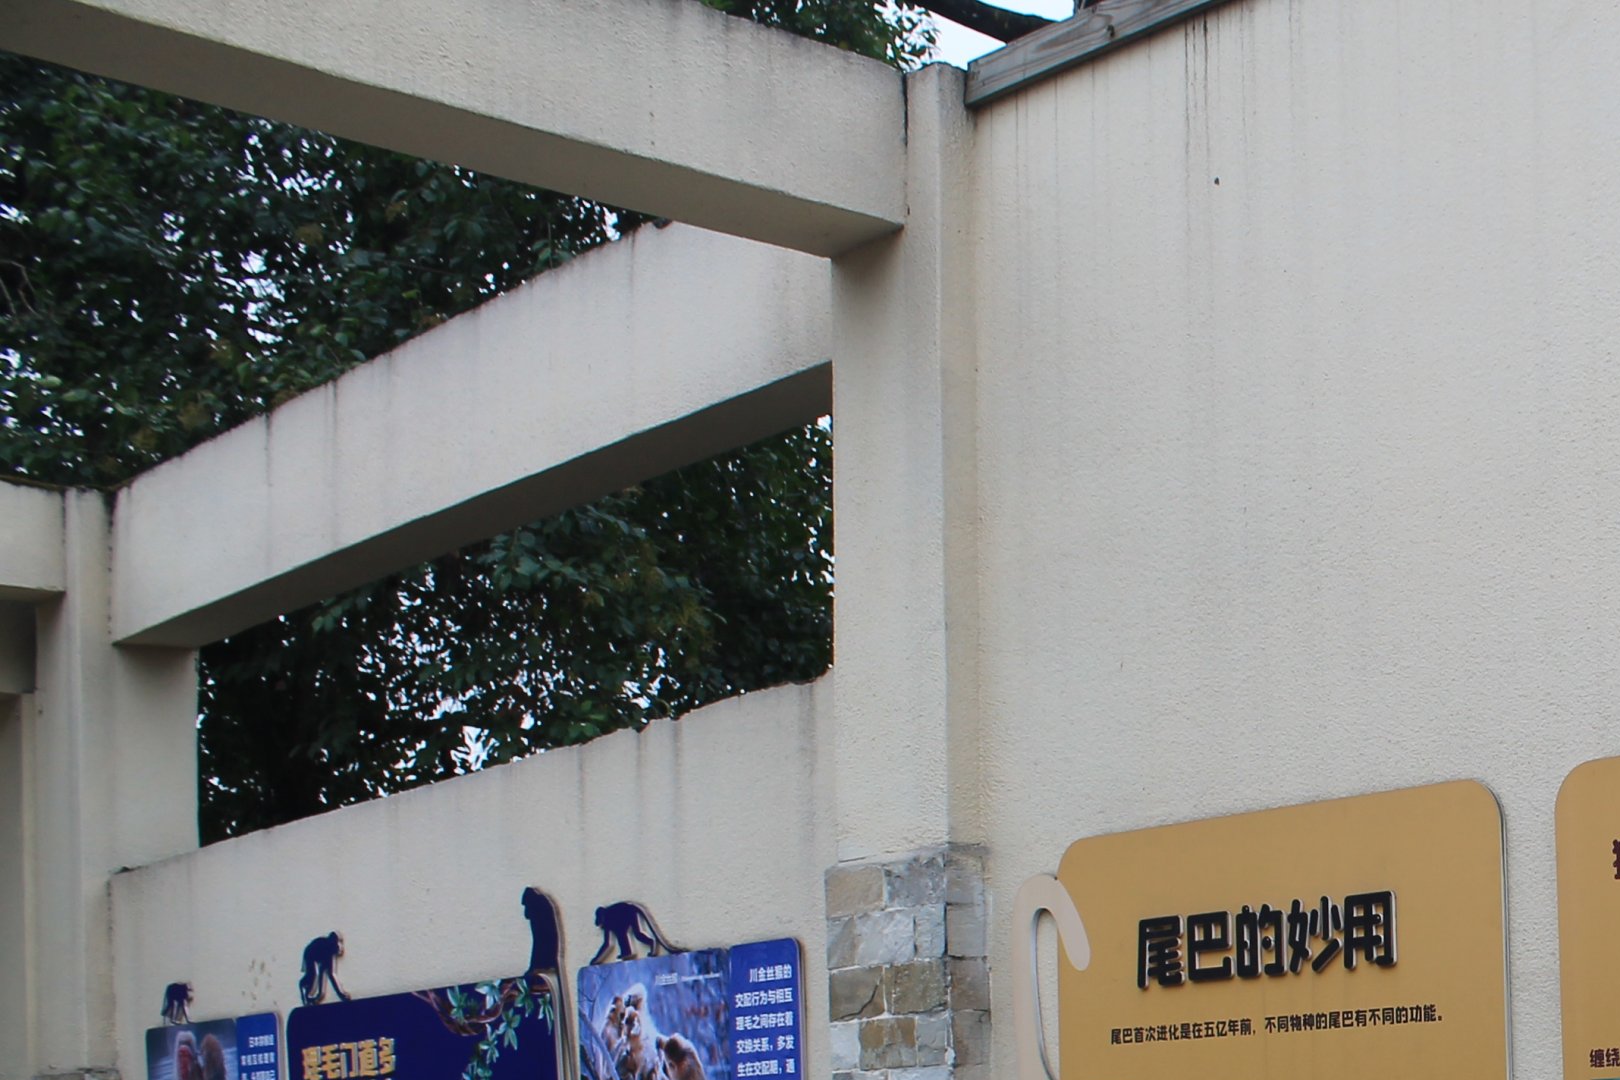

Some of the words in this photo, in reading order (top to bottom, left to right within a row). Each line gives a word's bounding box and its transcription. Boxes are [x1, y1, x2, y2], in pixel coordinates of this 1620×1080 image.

[1137, 890, 1398, 990] 尾巴的妙用
[749, 964, 793, 983] 川金丝猴的
[735, 987, 794, 1009] 交配行为与相互
[1110, 1004, 1444, 1045] 尾巴首次进化是在五亿年前，不同物种的尾巴有不同的功能。
